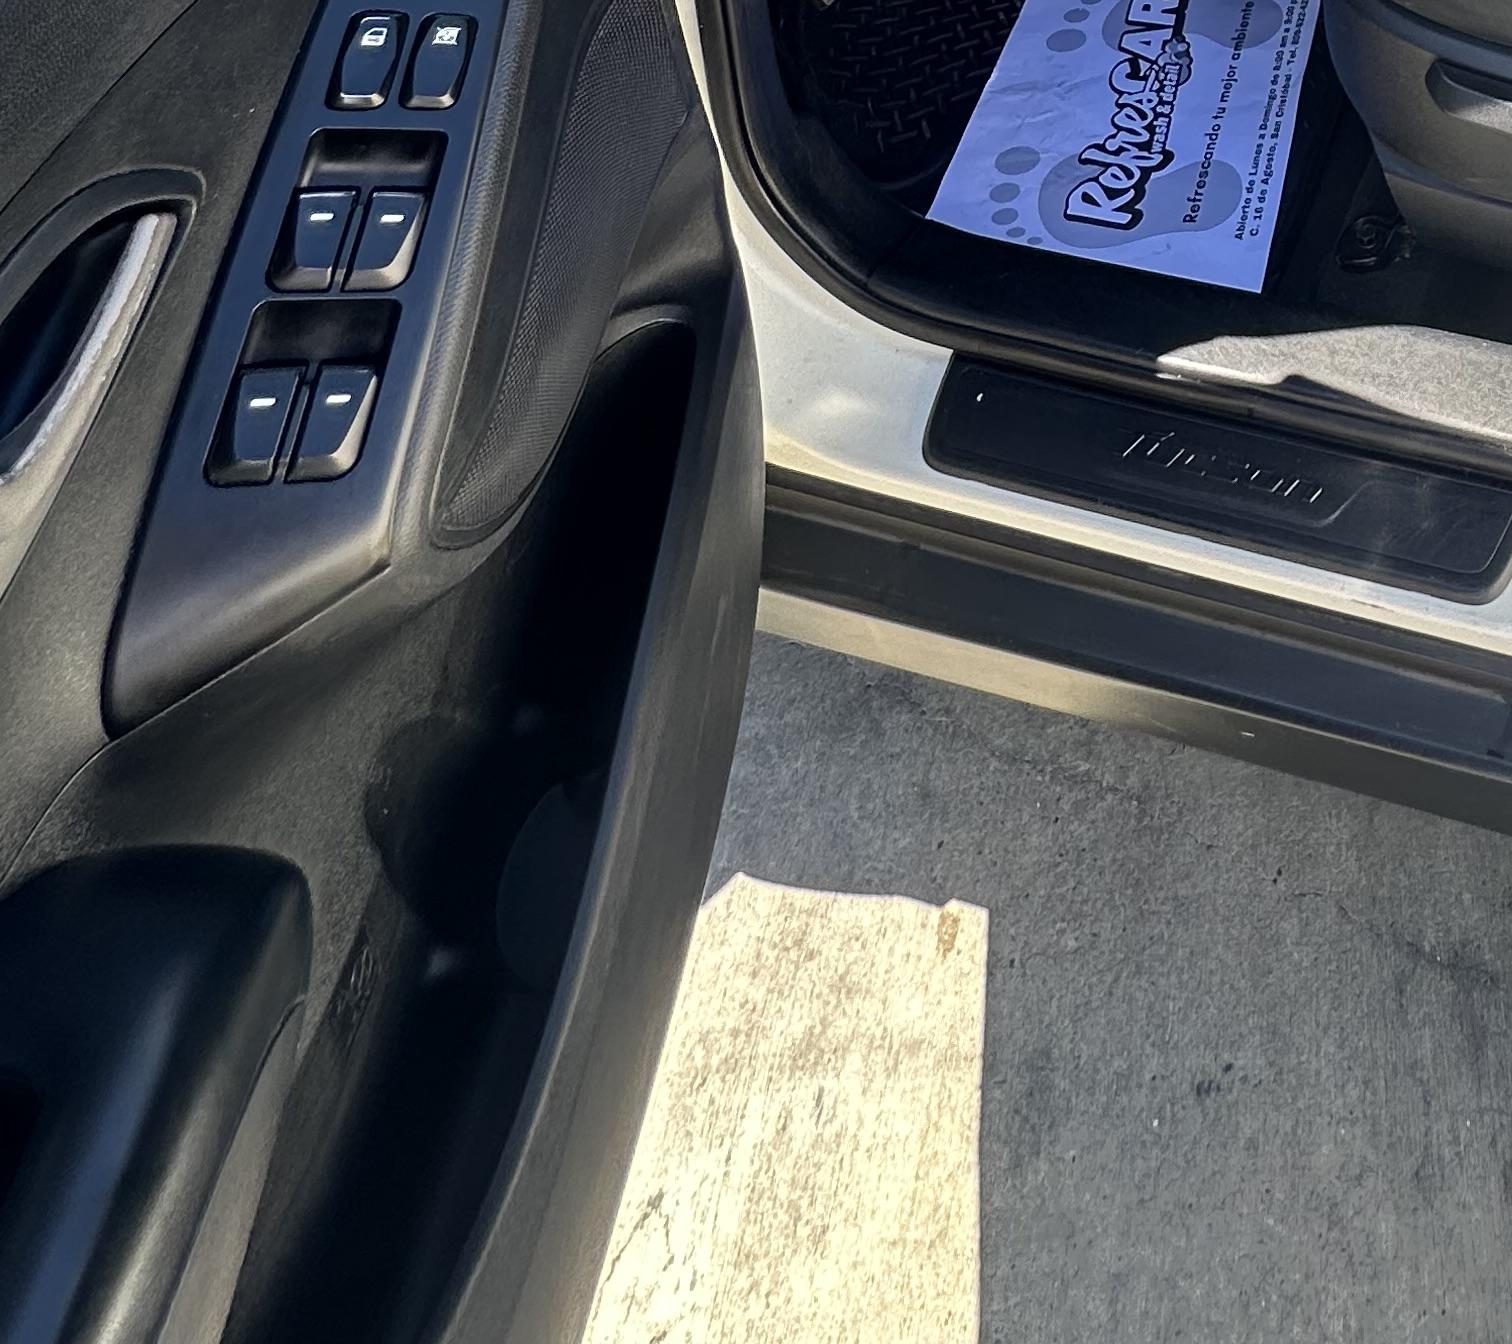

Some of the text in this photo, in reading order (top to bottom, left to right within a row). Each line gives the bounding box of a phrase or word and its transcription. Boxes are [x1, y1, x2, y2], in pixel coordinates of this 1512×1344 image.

[1150, 64, 1180, 153] wash & detail
[1182, 1, 1255, 224] Refrescando tu mejor ambiente
[1234, 197, 1252, 240] Abierto
[1248, 142, 1264, 176] Lunes
[1258, 88, 1277, 131] Domingo
[1270, 121, 1281, 140] San
